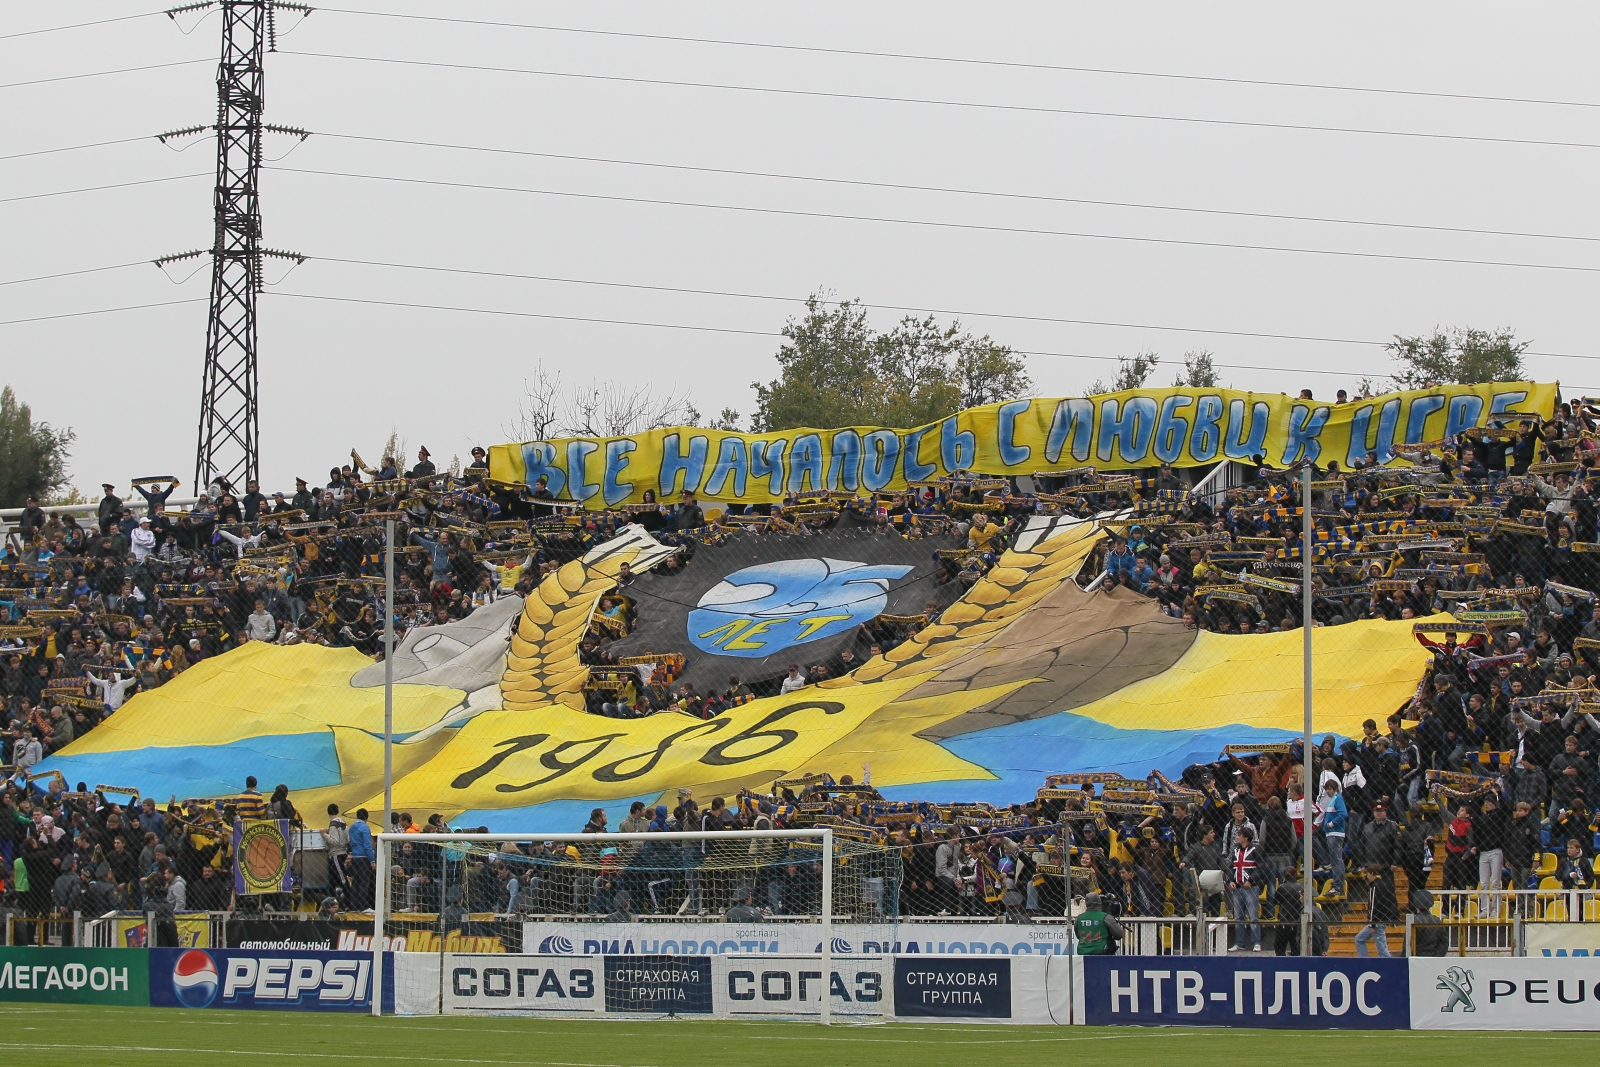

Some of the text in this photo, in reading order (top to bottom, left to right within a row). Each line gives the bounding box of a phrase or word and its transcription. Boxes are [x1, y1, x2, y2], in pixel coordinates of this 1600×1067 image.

[520, 438, 637, 506] ВСЕ
[659, 416, 976, 497] НАЧАЛОСЬ
[998, 399, 1032, 466] С
[1045, 394, 1270, 465] ЛЮБВИ
[1282, 404, 1331, 466] К
[1403, 443, 1436, 452] РОСТОВ
[697, 557, 914, 617] 25
[698, 615, 852, 651] ЛЕТ
[450, 701, 845, 792] 1986
[1439, 771, 1479, 785] РОСТОВ
[1080, 919, 1092, 927] ТВ
[735, 929, 779, 939] sport.ria.ru
[1028, 930, 1074, 941] sport.ria.
[239, 938, 331, 950] автомобильный
[223, 957, 371, 1001] PEPSI
[452, 967, 595, 999] СОГАЗ
[616, 969, 699, 983] СТРАХОВАЯ
[906, 972, 998, 986] СТРАХОВАЯ
[631, 987, 686, 1000] ГРУППА
[728, 971, 883, 1003] СОГАЗ
[1110, 969, 1382, 1016] НТВ-ПЛЮС
[1489, 979, 1600, 1004] PEU
[922, 990, 983, 1004] ГРУППА
